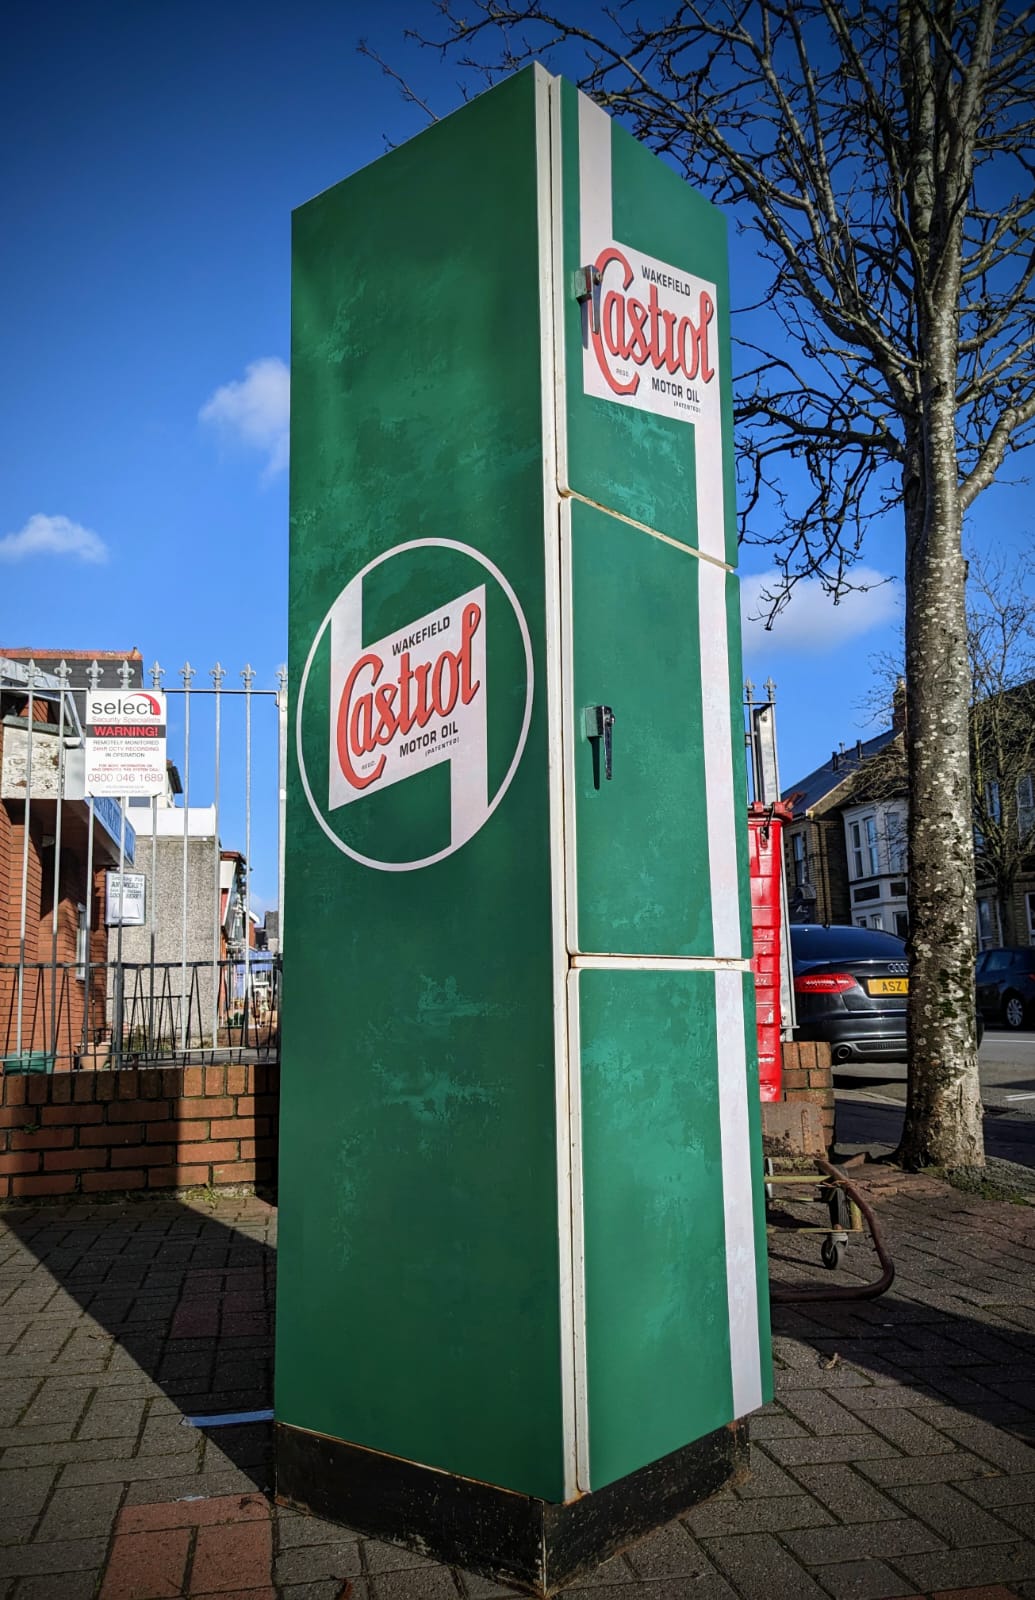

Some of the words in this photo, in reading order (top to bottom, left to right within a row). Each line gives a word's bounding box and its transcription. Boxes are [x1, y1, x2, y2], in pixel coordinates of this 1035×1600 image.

[641, 264, 691, 297] WAKEFIELD
[588, 247, 715, 395] Castrol
[651, 376, 683, 399] MOTOR
[686, 387, 700, 403] OIL
[392, 615, 450, 657] WAKEFIELD
[91, 699, 156, 716] select
[336, 602, 482, 790] Castrol
[92, 716, 120, 725] Security
[123, 716, 161, 724] Specialists
[93, 726, 159, 737] WARNING!
[399, 730, 437, 758] MOTOR
[441, 721, 459, 738] OIL
[88, 773, 113, 783] 0800
[116, 773, 135, 783] 046
